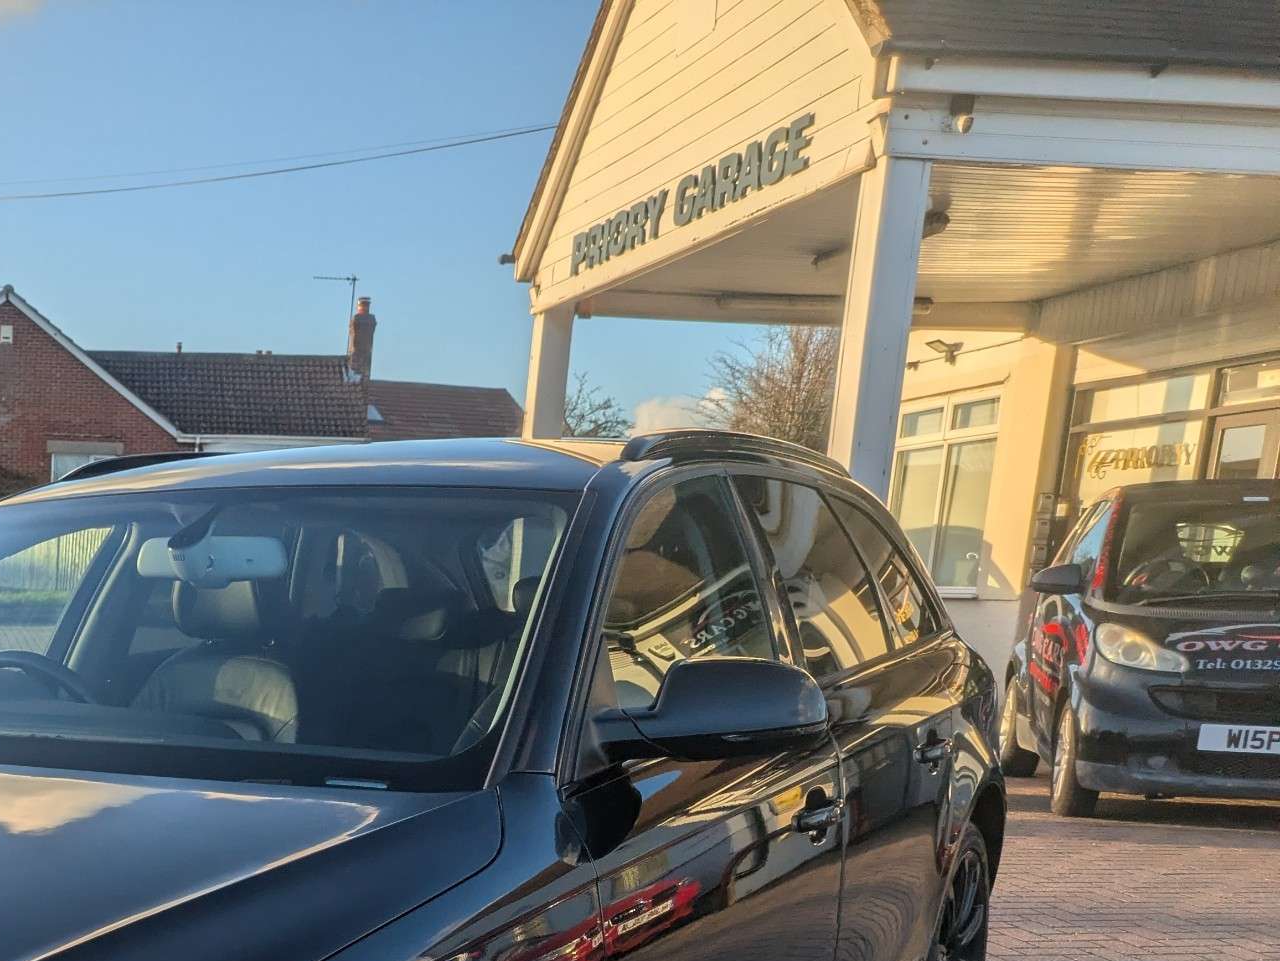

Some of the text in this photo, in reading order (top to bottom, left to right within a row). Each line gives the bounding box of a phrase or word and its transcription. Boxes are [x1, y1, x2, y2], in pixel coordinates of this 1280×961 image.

[570, 112, 815, 275] PRIORY GARAGE
[1176, 640, 1269, 652] OWG
